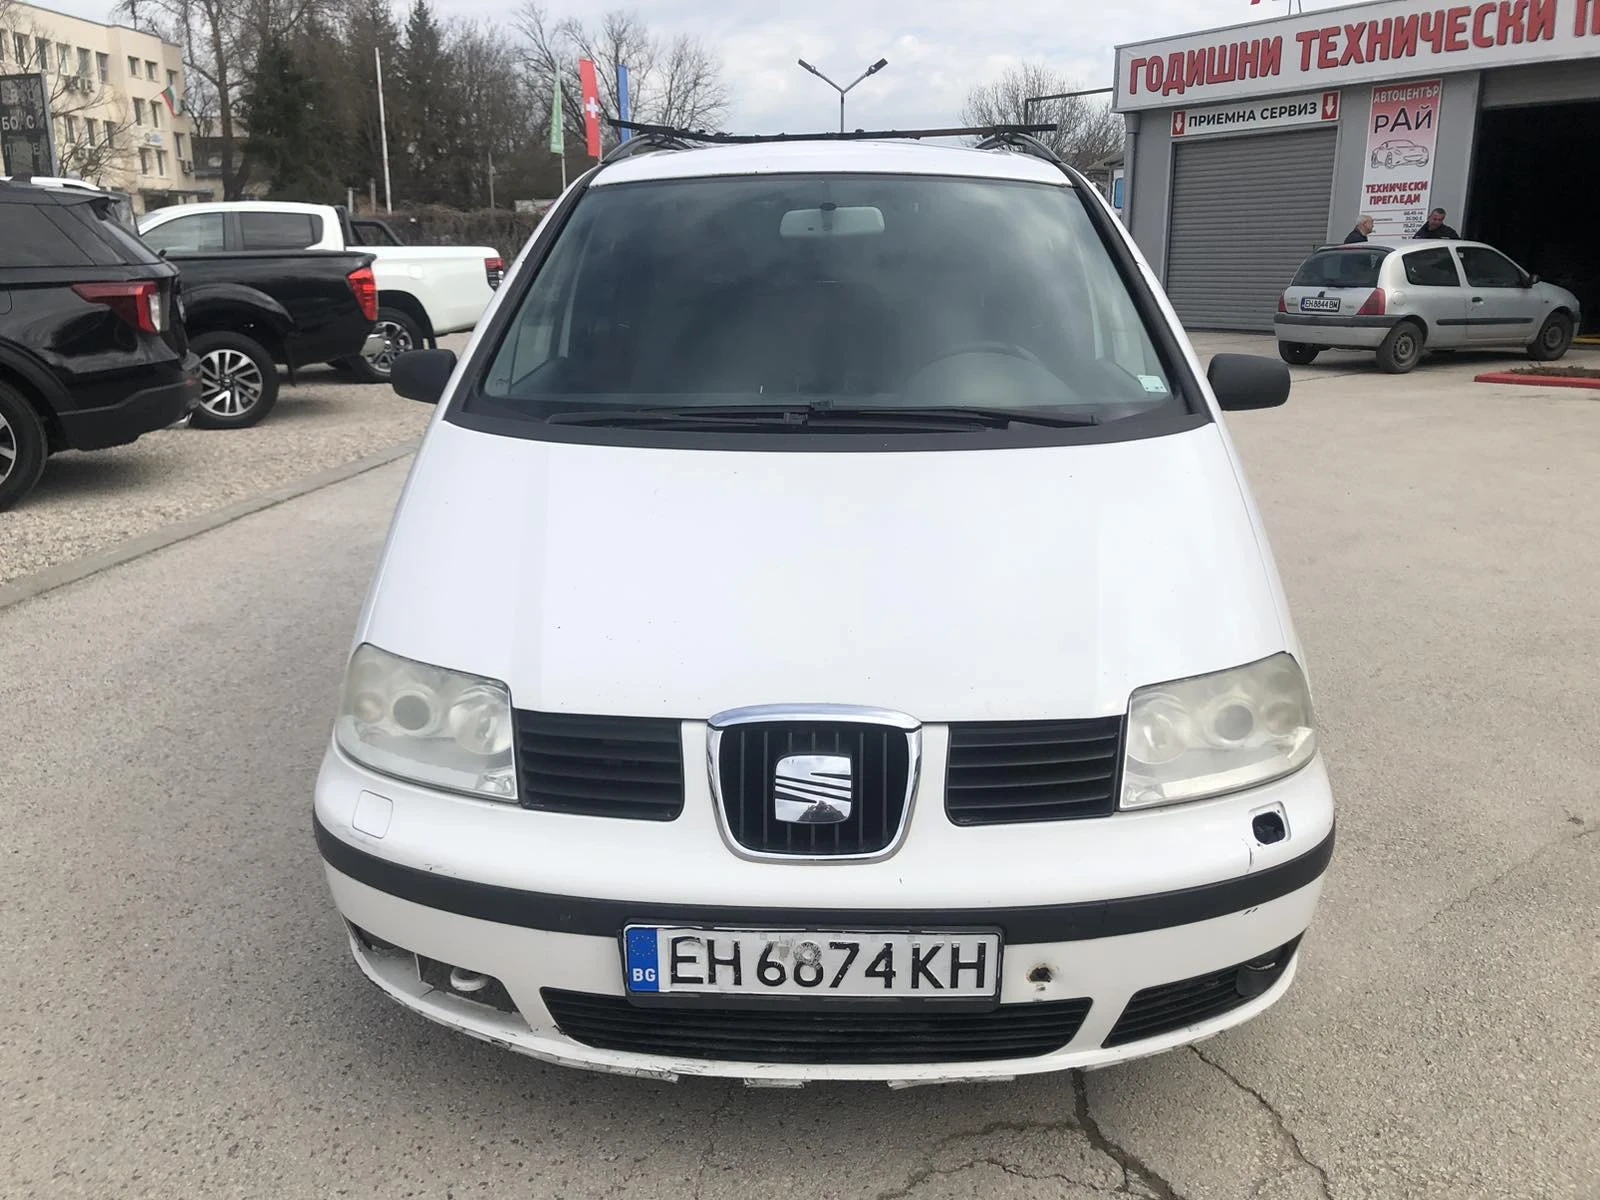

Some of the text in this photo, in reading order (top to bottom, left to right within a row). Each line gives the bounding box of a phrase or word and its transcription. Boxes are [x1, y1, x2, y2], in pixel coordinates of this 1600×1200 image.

[1129, 35, 1283, 96] ГОДИШНИ
[1296, 0, 1558, 71] ТЕХНИЧЕСКИ
[1373, 85, 1440, 105] АВТОЦЕНТЪР
[1188, 102, 1318, 128] ПРИЕМНА СЕРВИЗ
[1374, 104, 1433, 134] РАЙ
[1366, 181, 1428, 193] ТЕХНИЧЕСКИ
[1369, 193, 1421, 206] ПРЕГЛЕДИ
[670, 936, 986, 989] EH 6874 KH
[632, 967, 656, 983] BG
